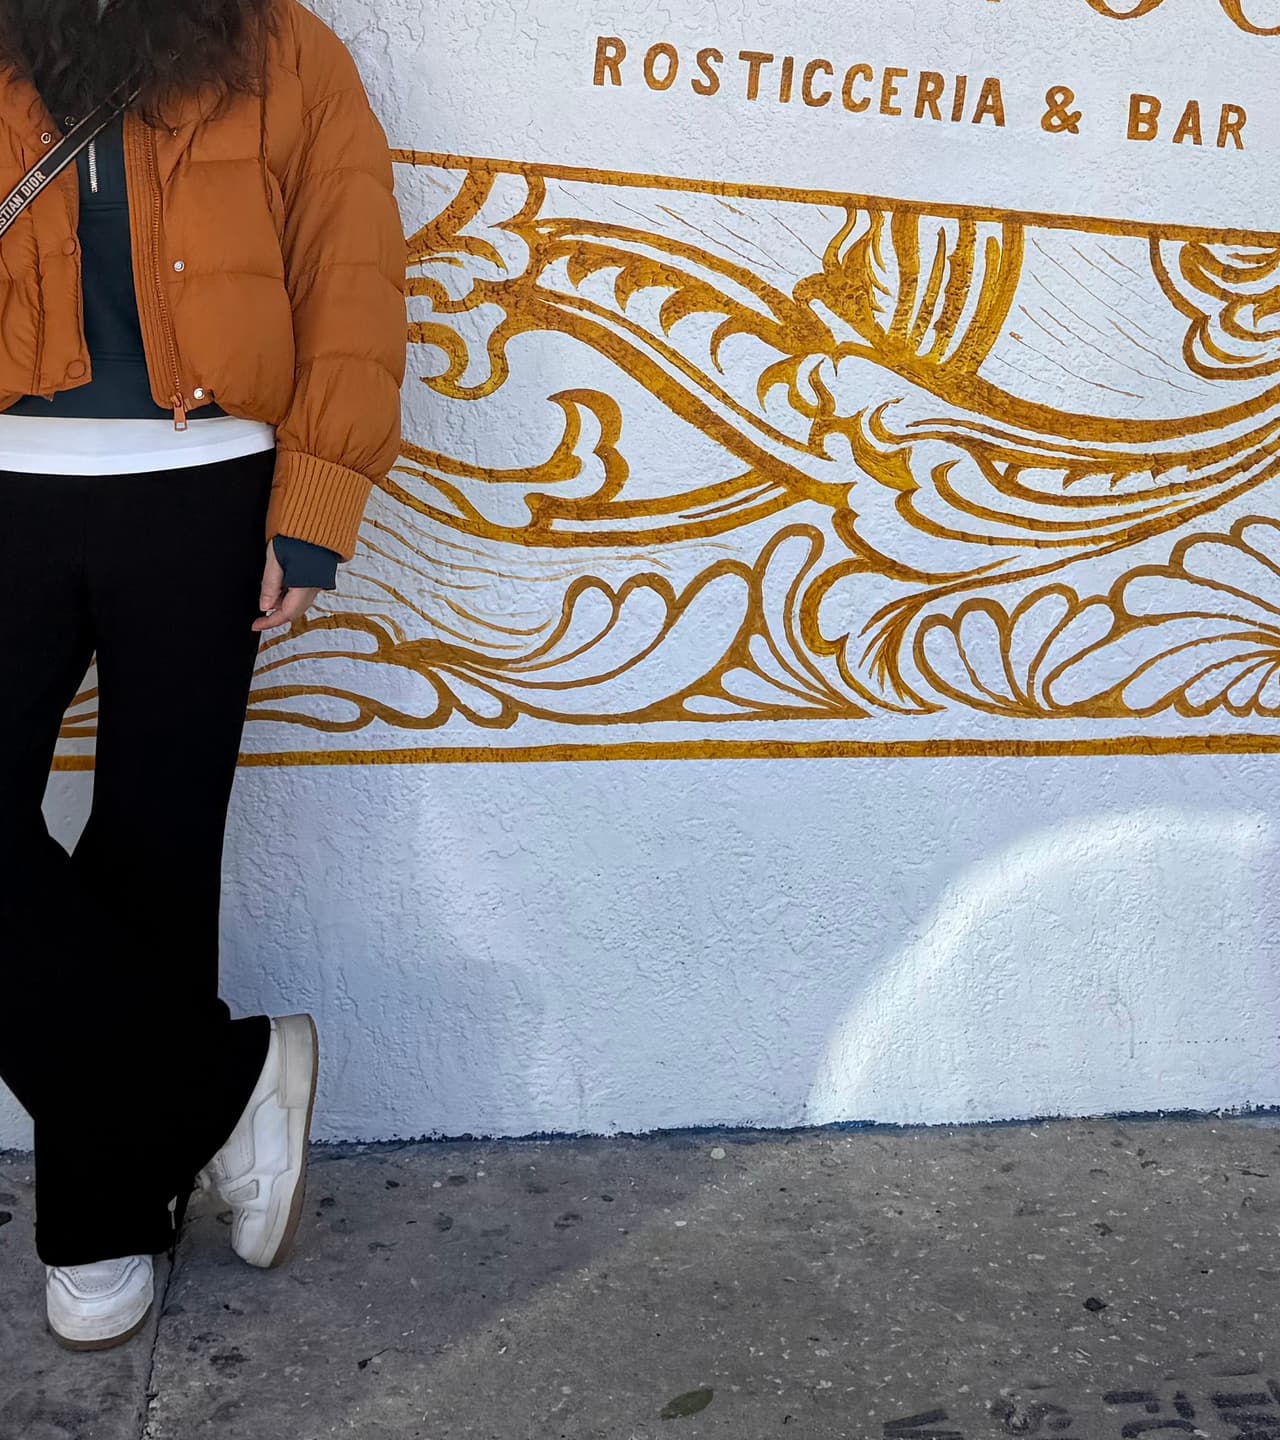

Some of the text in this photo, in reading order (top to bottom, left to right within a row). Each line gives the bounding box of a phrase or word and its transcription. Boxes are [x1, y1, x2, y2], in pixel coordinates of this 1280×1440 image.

[593, 36, 1247, 150] ROSTICCERIA & BAR
[20, 170, 46, 197] DIOR
